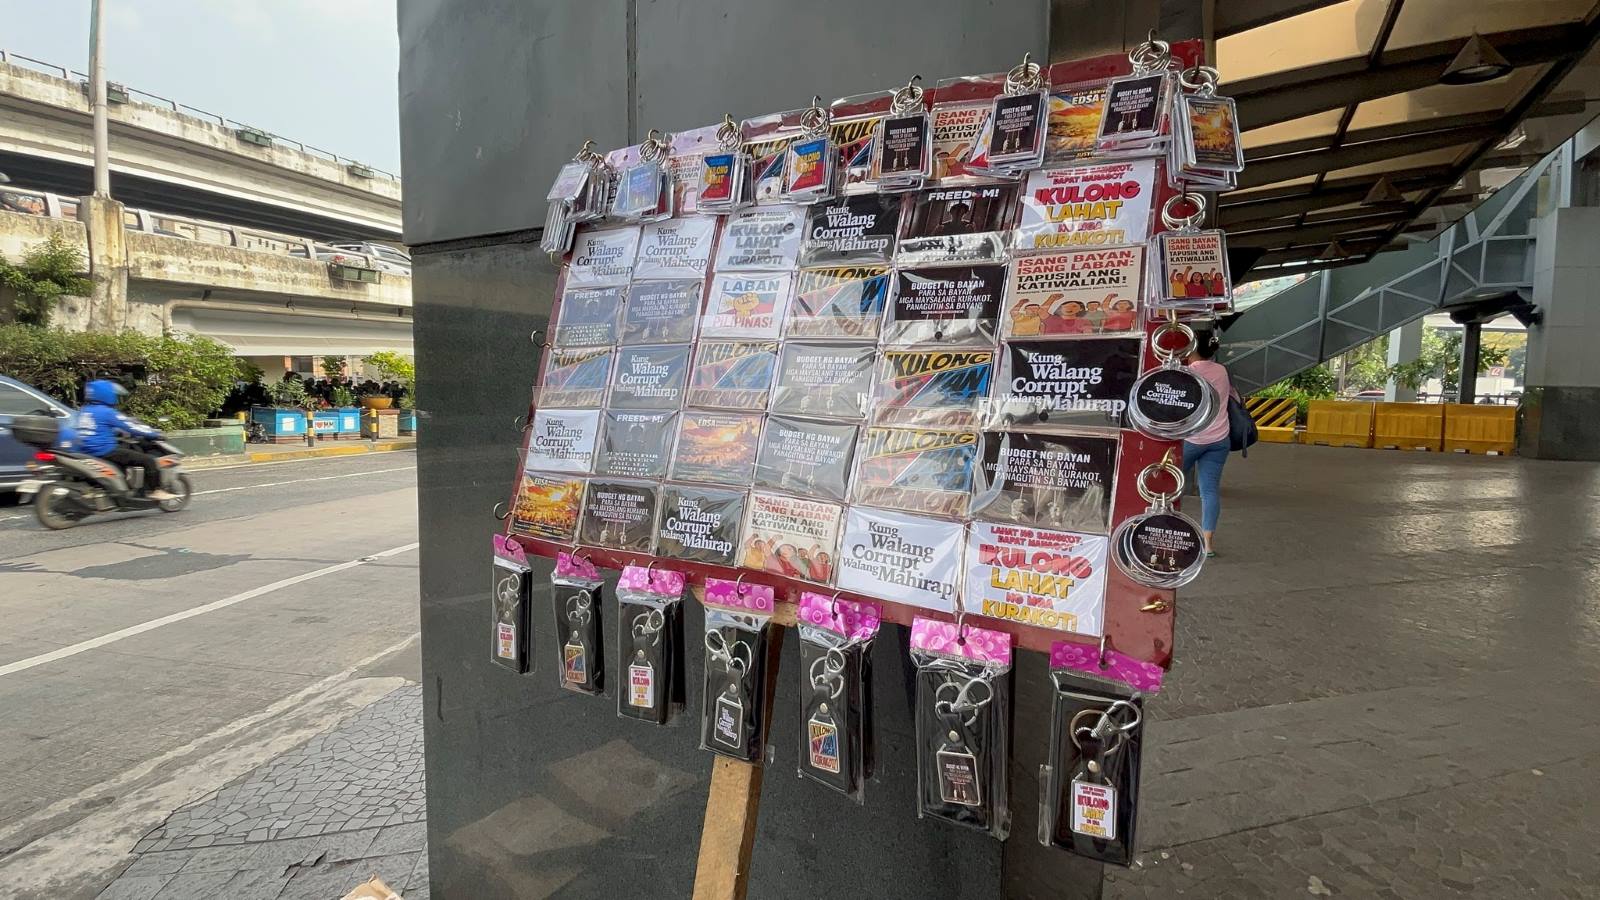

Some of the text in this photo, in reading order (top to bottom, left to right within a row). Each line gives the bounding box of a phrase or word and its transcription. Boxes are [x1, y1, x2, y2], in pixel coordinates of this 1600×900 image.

[1071, 94, 1100, 105] EDSA
[934, 117, 972, 127] ISANG
[936, 110, 977, 120] ISANG
[1035, 180, 1141, 205] IKULONG
[826, 206, 850, 216] Kung
[1047, 201, 1123, 223] LAHAT
[827, 212, 877, 229] Walang
[658, 234, 698, 248] Walang
[812, 225, 865, 242] Corrupt
[1034, 229, 1125, 248] KURAKOT!
[735, 235, 785, 249] LAHAT
[804, 237, 889, 253] Walang Mahirap
[588, 245, 624, 257] Walang
[645, 245, 688, 259] Corrupt
[577, 255, 614, 267] Corrupt
[660, 255, 707, 270] Mahirap
[1018, 250, 1136, 268] ISANG BAYAN,
[1017, 259, 1134, 275] ISANG LABAN:
[1017, 268, 1121, 283] TAPUSIN ANG
[722, 280, 780, 292] LABAN
[911, 280, 985, 290] BUDGET NG BAYAN
[1017, 276, 1127, 291] KATIWALIAN!
[899, 296, 914, 304] MGA
[915, 296, 956, 304] MAYSALANG
[945, 302, 954, 310] SA
[712, 315, 773, 329] PILIPINAS!
[631, 355, 649, 363] Kung
[1027, 352, 1063, 366] Kung
[632, 362, 669, 377] Walang
[1031, 362, 1103, 385] Walang
[620, 373, 660, 388] Corrupt
[1011, 376, 1089, 397] Corrupt
[634, 383, 678, 401] Mahirap
[1146, 390, 1180, 400] Corrupt
[1156, 385, 1187, 398] Walang
[1002, 392, 1127, 418] Walang Mahirap
[1158, 398, 1195, 410] Mahirap
[545, 418, 564, 426] Kung
[546, 425, 583, 441] Walang
[780, 430, 805, 439] BUDGET
[818, 434, 840, 444] BAYAN
[535, 435, 575, 449] Corrupt
[549, 447, 592, 464] Mahirap
[1000, 448, 1091, 463] BUDGET NG BAYAN
[1010, 456, 1031, 466] PARA
[1032, 459, 1044, 468] SA
[986, 462, 1102, 482] MGA MAYSALANG KURAKOT.
[995, 472, 1041, 484] PANAGUTIN
[1043, 476, 1056, 485] SA
[1058, 478, 1090, 489] BAYAN!
[677, 497, 698, 508] Kung
[755, 496, 790, 508] ISANG
[679, 506, 722, 528] Walang
[752, 511, 825, 529] TAPUSIN ANG
[753, 504, 834, 522] ISANG LABAN:
[666, 518, 713, 538] Corrupt
[752, 518, 828, 538] KATIWALIAN!
[868, 521, 899, 538] Kung
[990, 526, 1019, 536] LAHAT
[1144, 526, 1164, 534] BUDGET
[660, 529, 684, 541] Walang
[682, 533, 733, 557] Mahirap
[869, 532, 936, 564] Walang
[852, 544, 920, 573] Corrupt
[979, 543, 1093, 580] IKULONG
[842, 557, 955, 601] Walang Mahirap
[991, 567, 1075, 600] LAHAT
[982, 598, 1078, 633] KURAKOT!
